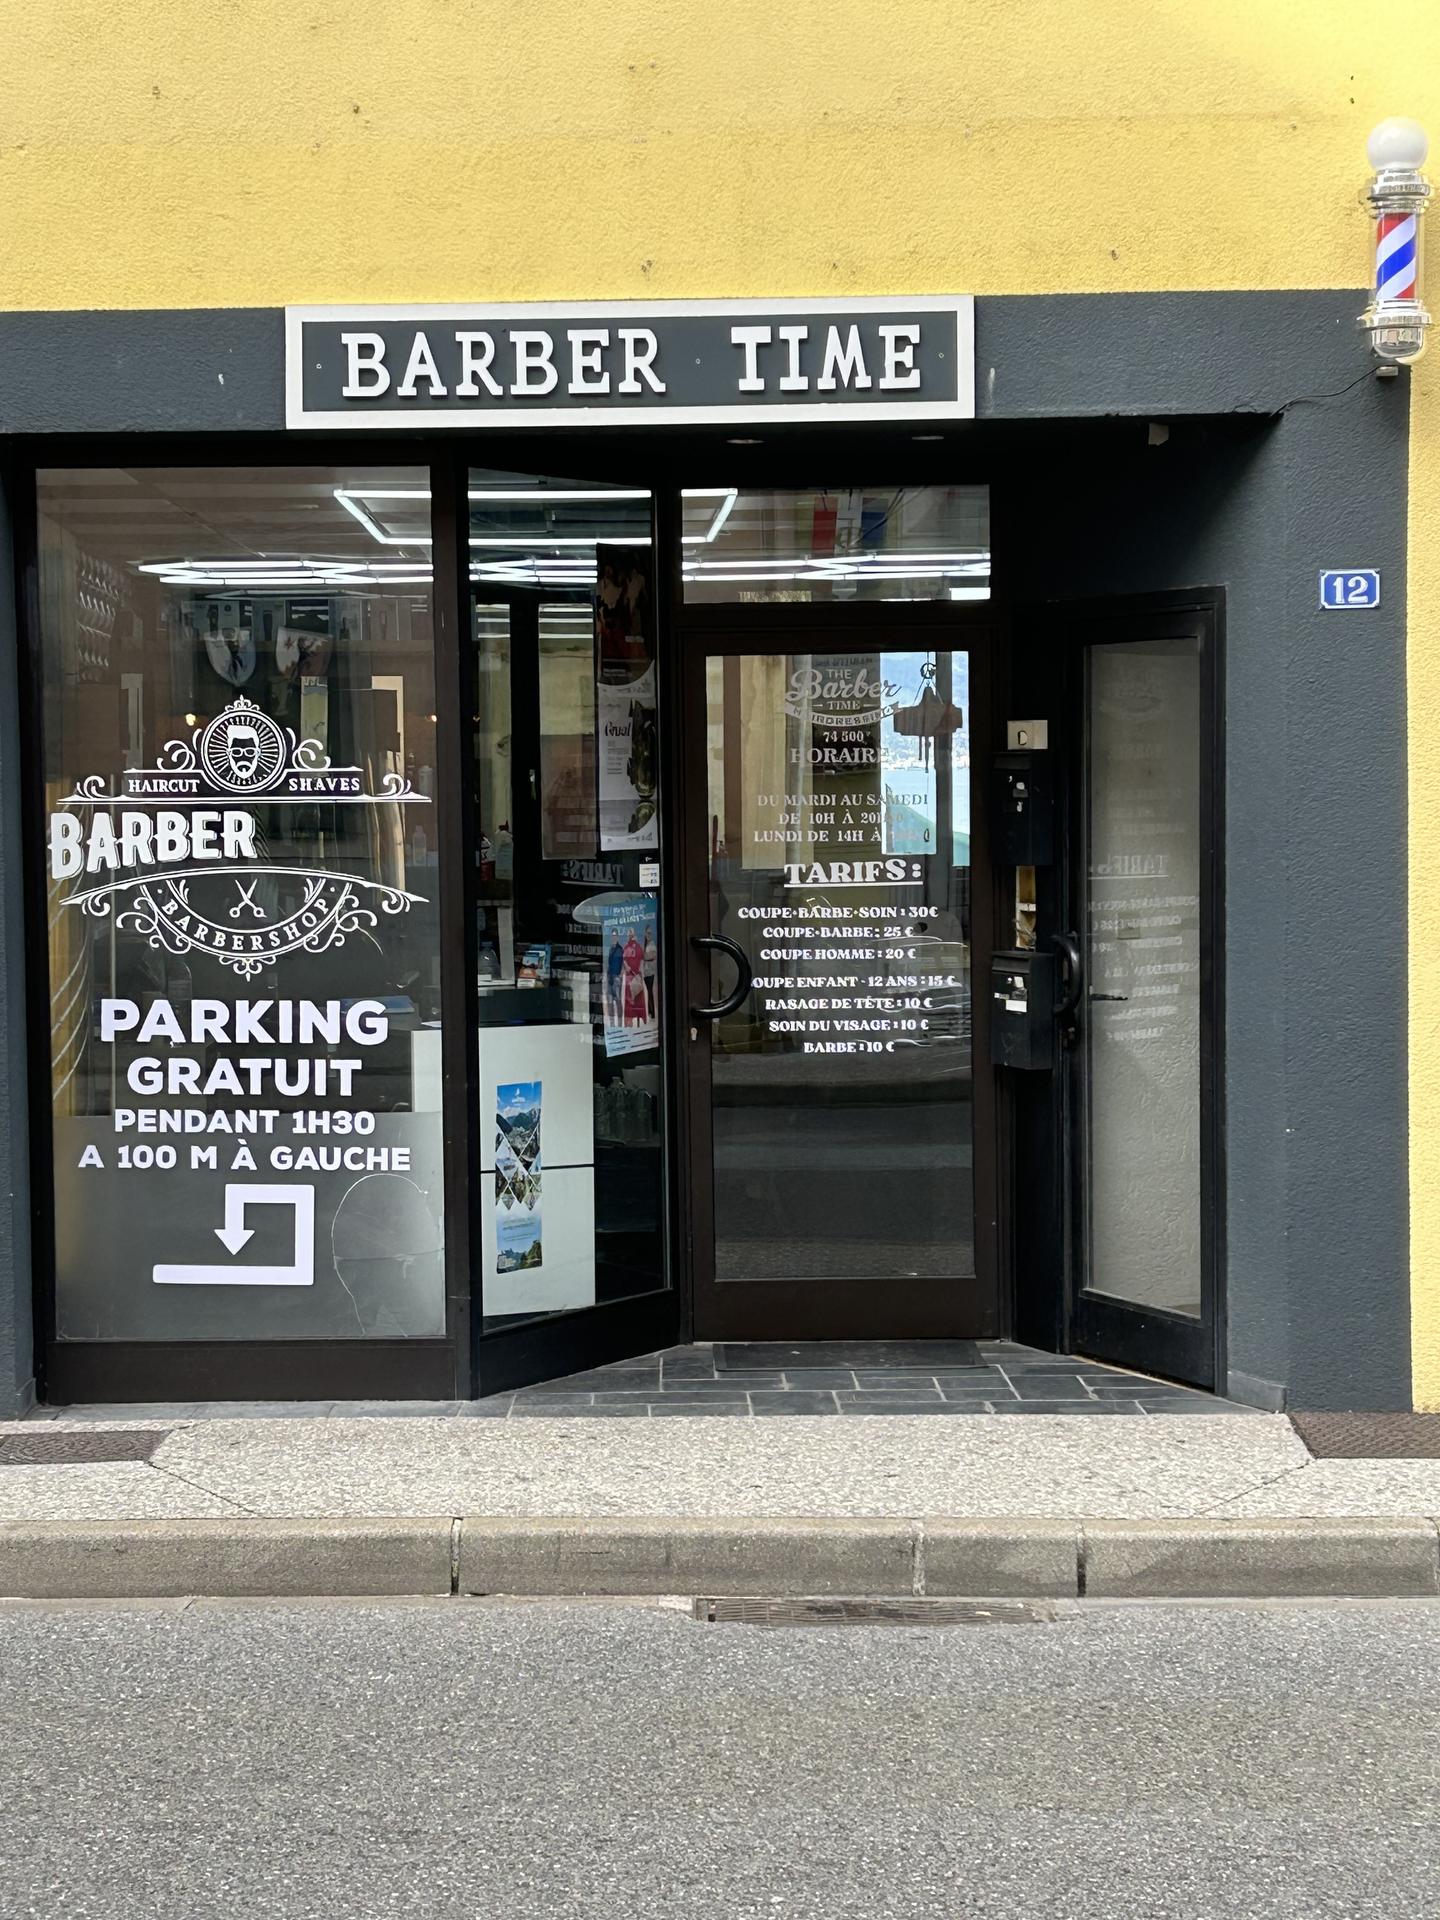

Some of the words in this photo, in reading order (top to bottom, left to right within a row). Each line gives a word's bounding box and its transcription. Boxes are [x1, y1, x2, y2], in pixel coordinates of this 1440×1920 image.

[340, 328, 667, 398] BARBER
[730, 324, 922, 392] TIME
[1332, 576, 1369, 604] 12
[825, 668, 853, 680] THE
[785, 668, 903, 702] Barber
[827, 700, 860, 711] TIME
[823, 731, 838, 743] 74
[841, 731, 864, 743] 500
[128, 779, 200, 794] HAIRCUT
[288, 777, 361, 792] SHAVES
[758, 794, 779, 806] DU
[785, 794, 836, 806] MARDI
[841, 793, 862, 806] AU
[779, 812, 800, 825] DE
[809, 812, 835, 824] 10H
[842, 809, 854, 824] À
[754, 830, 803, 842] LUNDI
[807, 830, 829, 842] DE
[837, 830, 864, 842] 14H
[870, 827, 882, 842] À
[47, 810, 258, 880] BARBER
[908, 907, 939, 918] 30€
[161, 898, 329, 952] BARBERSHOP
[884, 927, 902, 938] 25
[760, 949, 812, 960] COUPE
[815, 948, 875, 960] HOMME
[885, 948, 905, 960] 20
[907, 948, 917, 959] €
[751, 977, 794, 988] OUPE
[797, 976, 858, 988] ENFANT
[868, 976, 883, 987] 12
[886, 976, 917, 987] ANS
[928, 976, 943, 987] 15
[765, 999, 829, 1010] RASAGE
[832, 999, 851, 1009] DE
[904, 997, 921, 1009] 10
[923, 997, 933, 1008] €
[100, 998, 388, 1046] PARKING
[769, 1020, 806, 1032] SOIN
[809, 1020, 830, 1031] DU
[833, 1020, 891, 1031] VISAGE
[901, 1019, 917, 1030] 10
[920, 1019, 929, 1030] €
[804, 1042, 856, 1053] BARBE
[869, 1042, 883, 1053] 10
[886, 1042, 895, 1053] €
[127, 1057, 362, 1097] GRATUIT
[114, 1109, 279, 1134] PENDANT
[292, 1110, 376, 1135] 1H30
[78, 1144, 104, 1168] A
[117, 1144, 177, 1169] 100
[190, 1145, 218, 1170] M
[231, 1139, 257, 1171] À
[270, 1146, 411, 1171] GAUCHE
